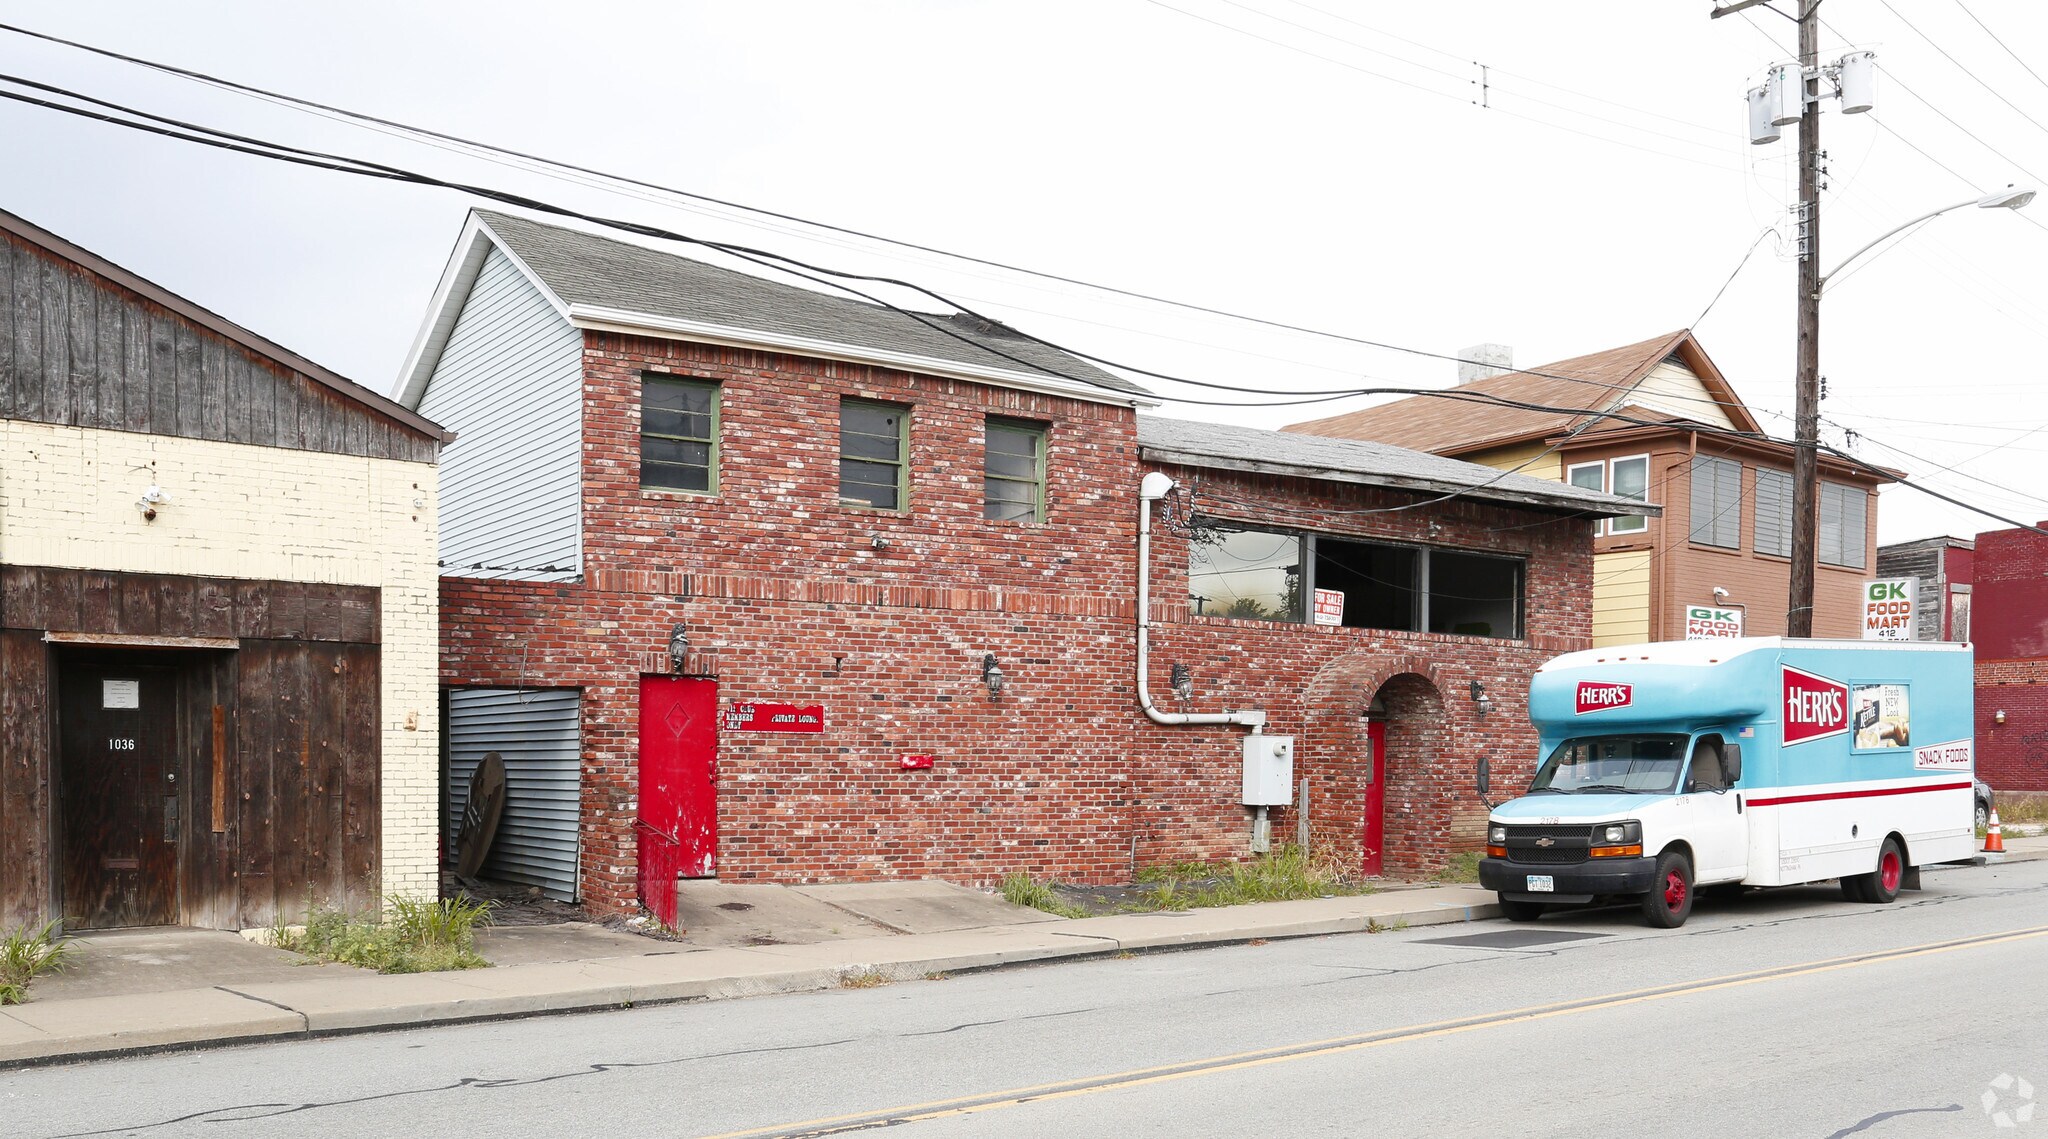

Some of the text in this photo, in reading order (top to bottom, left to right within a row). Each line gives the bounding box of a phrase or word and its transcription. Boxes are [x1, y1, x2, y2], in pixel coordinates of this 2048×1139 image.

[1869, 582, 1907, 600] GK
[1315, 592, 1342, 606] FOR SALE
[1323, 604, 1340, 615] OWNER
[1690, 608, 1734, 622] GK
[1867, 601, 1910, 615] FOOD
[1689, 619, 1739, 630] FOOD
[1867, 615, 1910, 630] MART
[1689, 627, 1738, 639] MART
[1879, 629, 1896, 637] 412
[1580, 686, 1626, 705] HERR'S
[1787, 686, 1842, 727] HERR'S
[109, 738, 135, 751] 1036
[1918, 748, 1969, 766] SNACK FOODS
